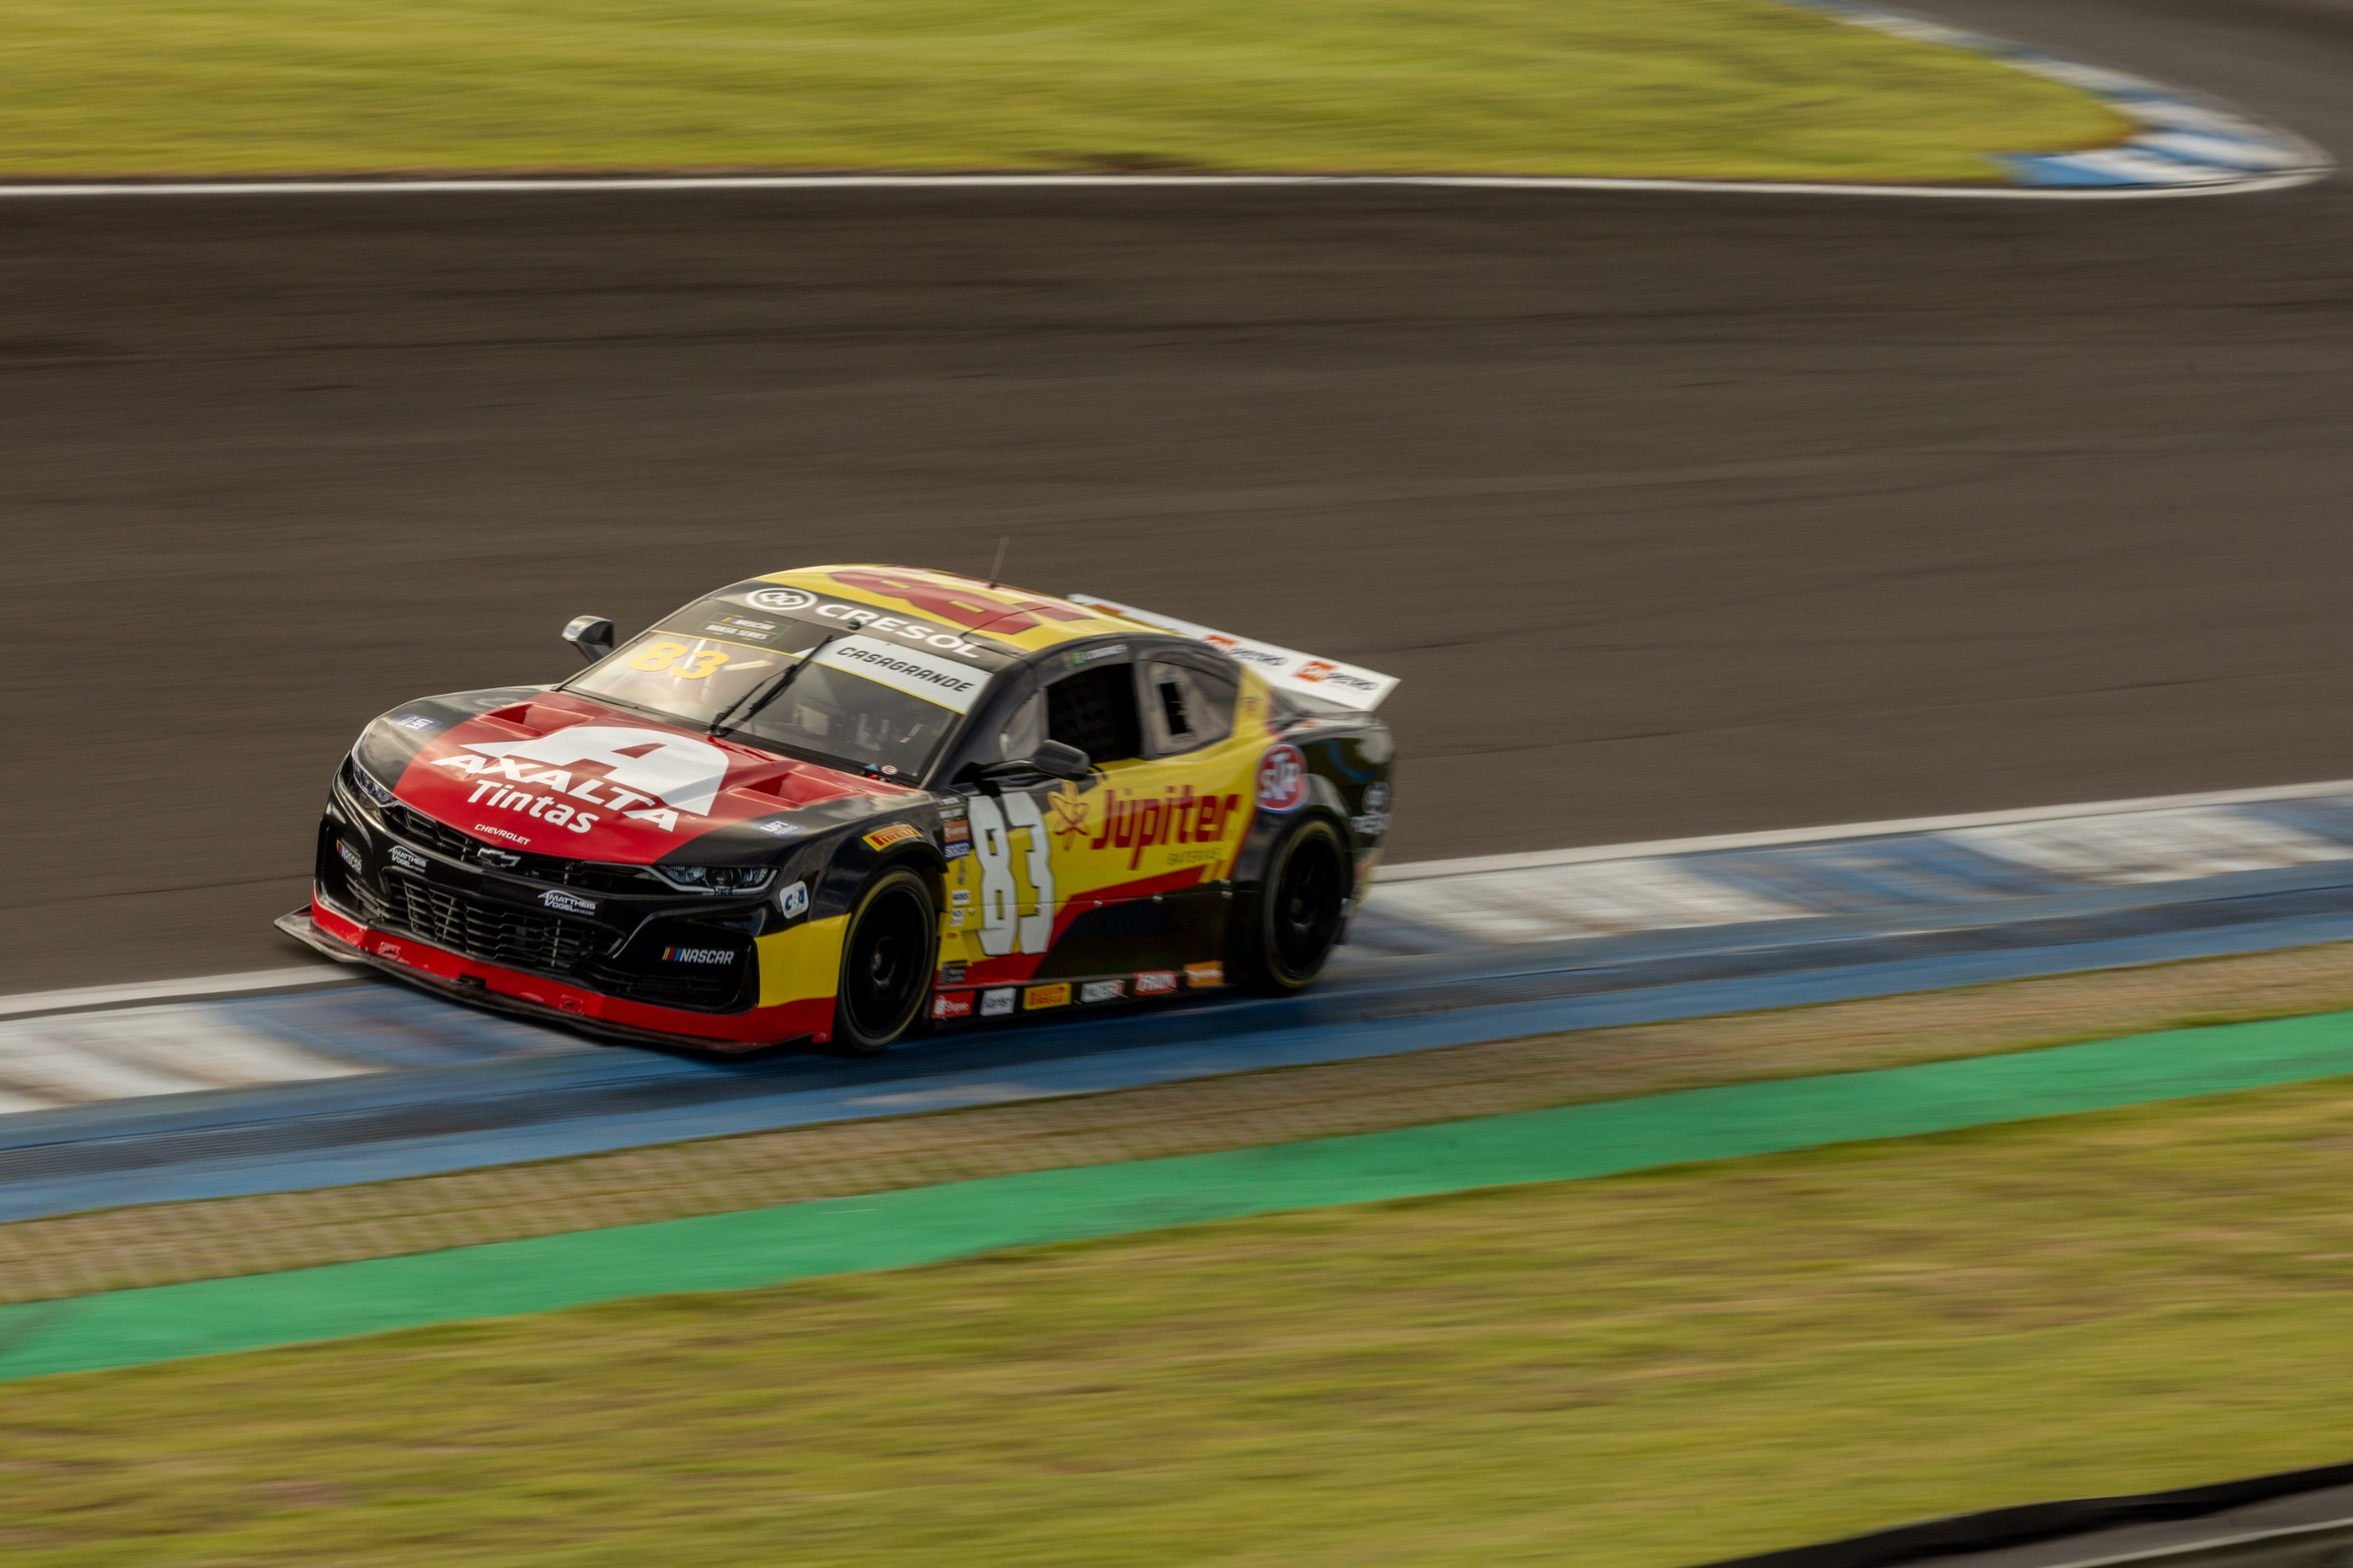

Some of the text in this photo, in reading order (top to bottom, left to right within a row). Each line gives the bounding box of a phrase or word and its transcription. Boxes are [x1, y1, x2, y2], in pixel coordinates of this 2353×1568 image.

[815, 603, 981, 659] CRESOL
[629, 642, 731, 680] 83
[835, 646, 976, 693] CASAGRANDE
[429, 754, 679, 833] AXALTA
[467, 778, 600, 834] Tintas
[474, 824, 531, 846] CHEVROLET
[341, 845, 362, 875] NASCAR
[968, 790, 1055, 956] 83
[678, 948, 734, 965] NASCAR
